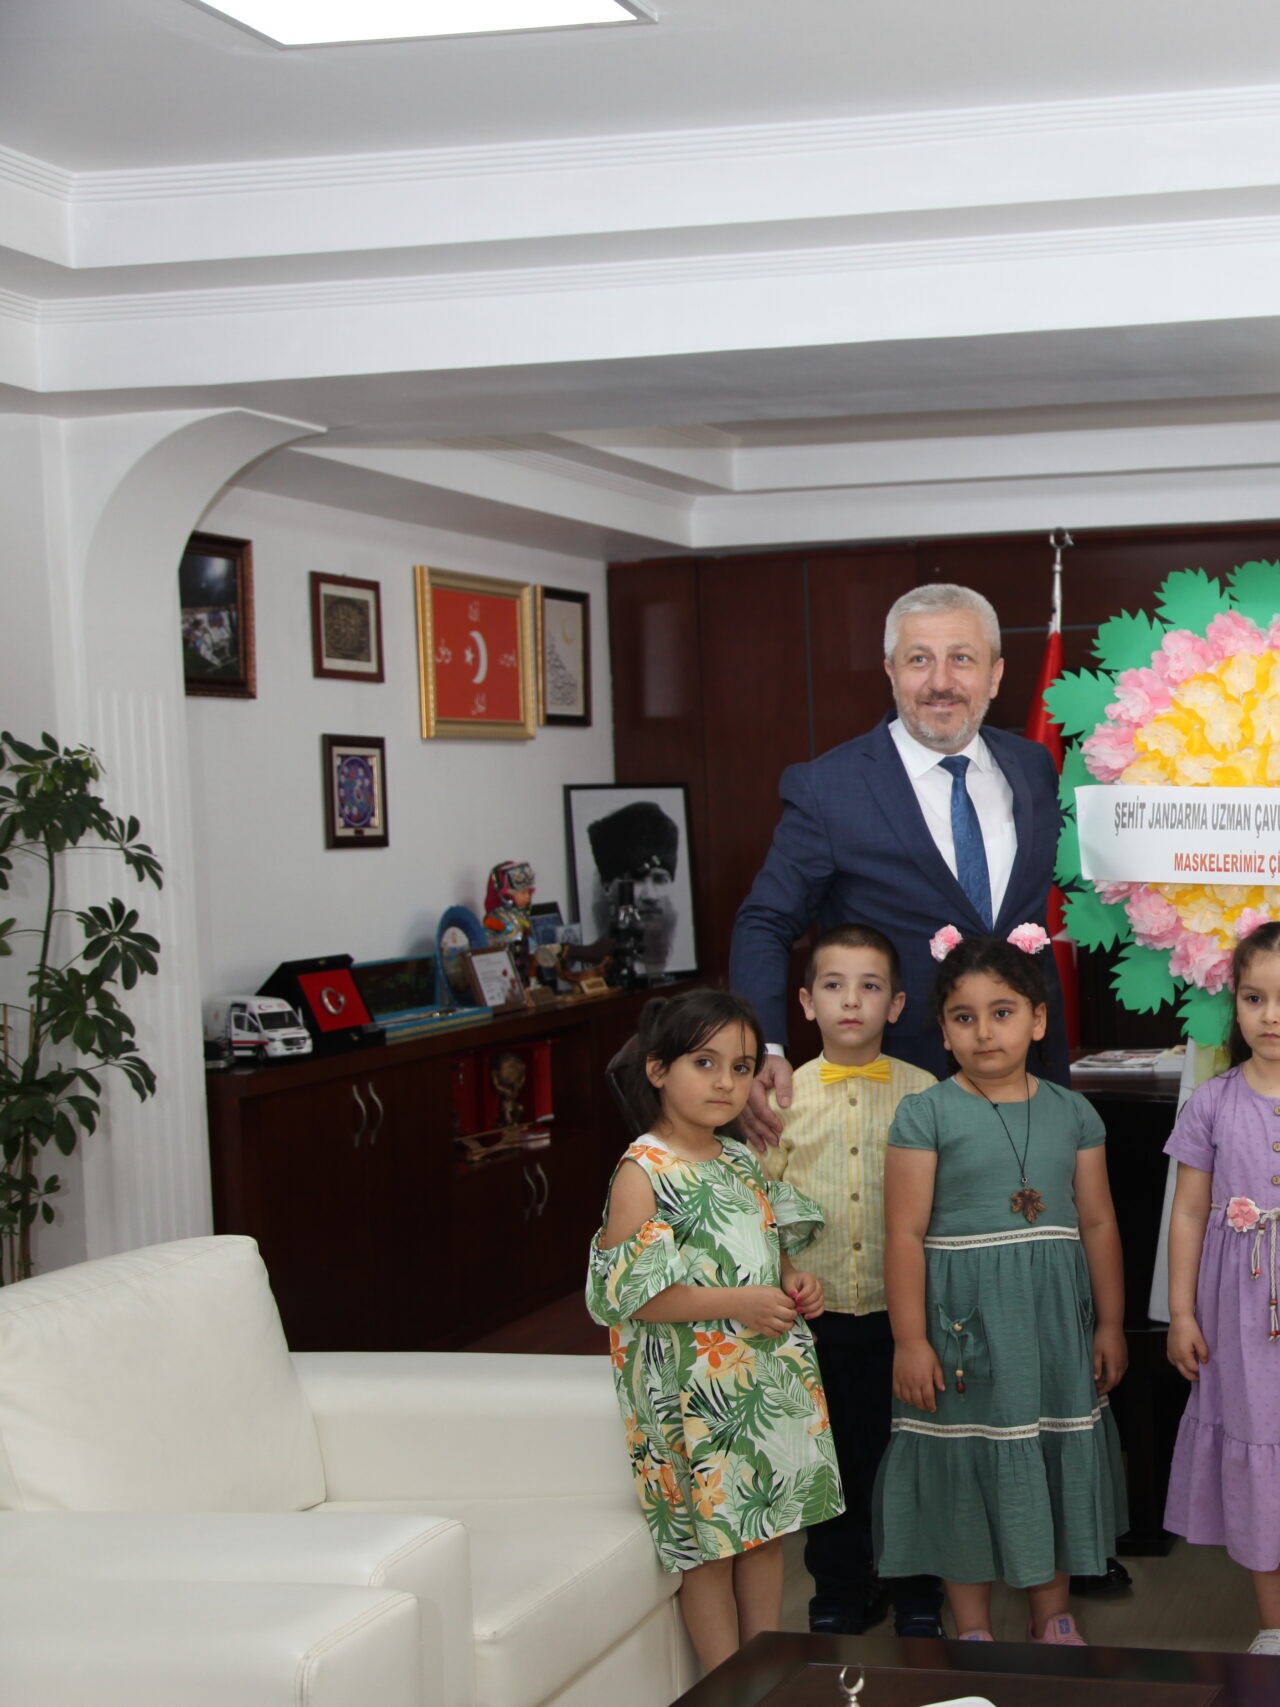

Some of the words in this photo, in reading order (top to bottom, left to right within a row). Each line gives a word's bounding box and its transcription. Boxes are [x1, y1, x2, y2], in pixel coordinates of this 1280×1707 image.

[1114, 796, 1147, 837] ŞEHİT
[1149, 802, 1208, 830] JANDARMA
[1211, 803, 1251, 831] UZMAN
[1174, 850, 1266, 873] MASKELERİMİZ
